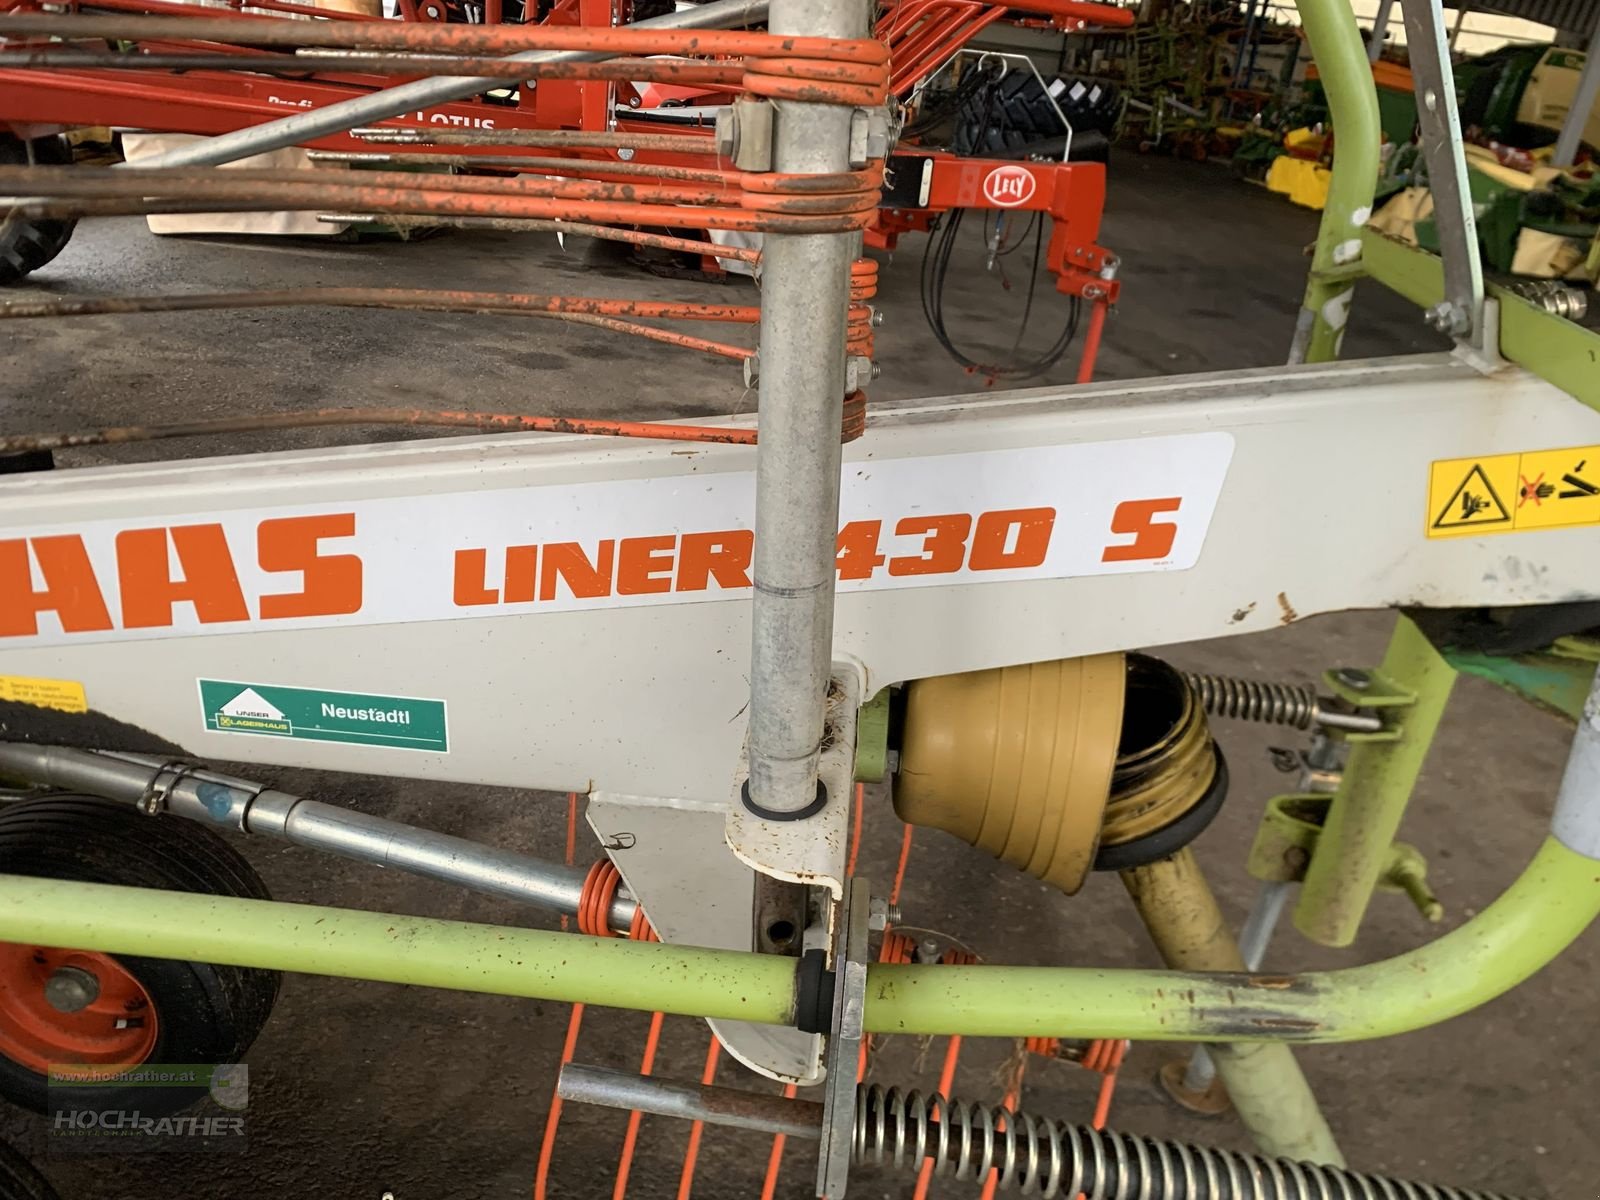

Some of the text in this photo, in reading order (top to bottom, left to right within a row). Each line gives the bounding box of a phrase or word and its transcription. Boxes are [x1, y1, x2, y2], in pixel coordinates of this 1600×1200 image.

[992, 173, 1027, 199] LELY
[0, 497, 1183, 637] AAS LINER 430 S
[230, 718, 289, 731] LAGERHAUS
[235, 709, 270, 719] UNSER
[321, 702, 411, 725] Neustadtl
